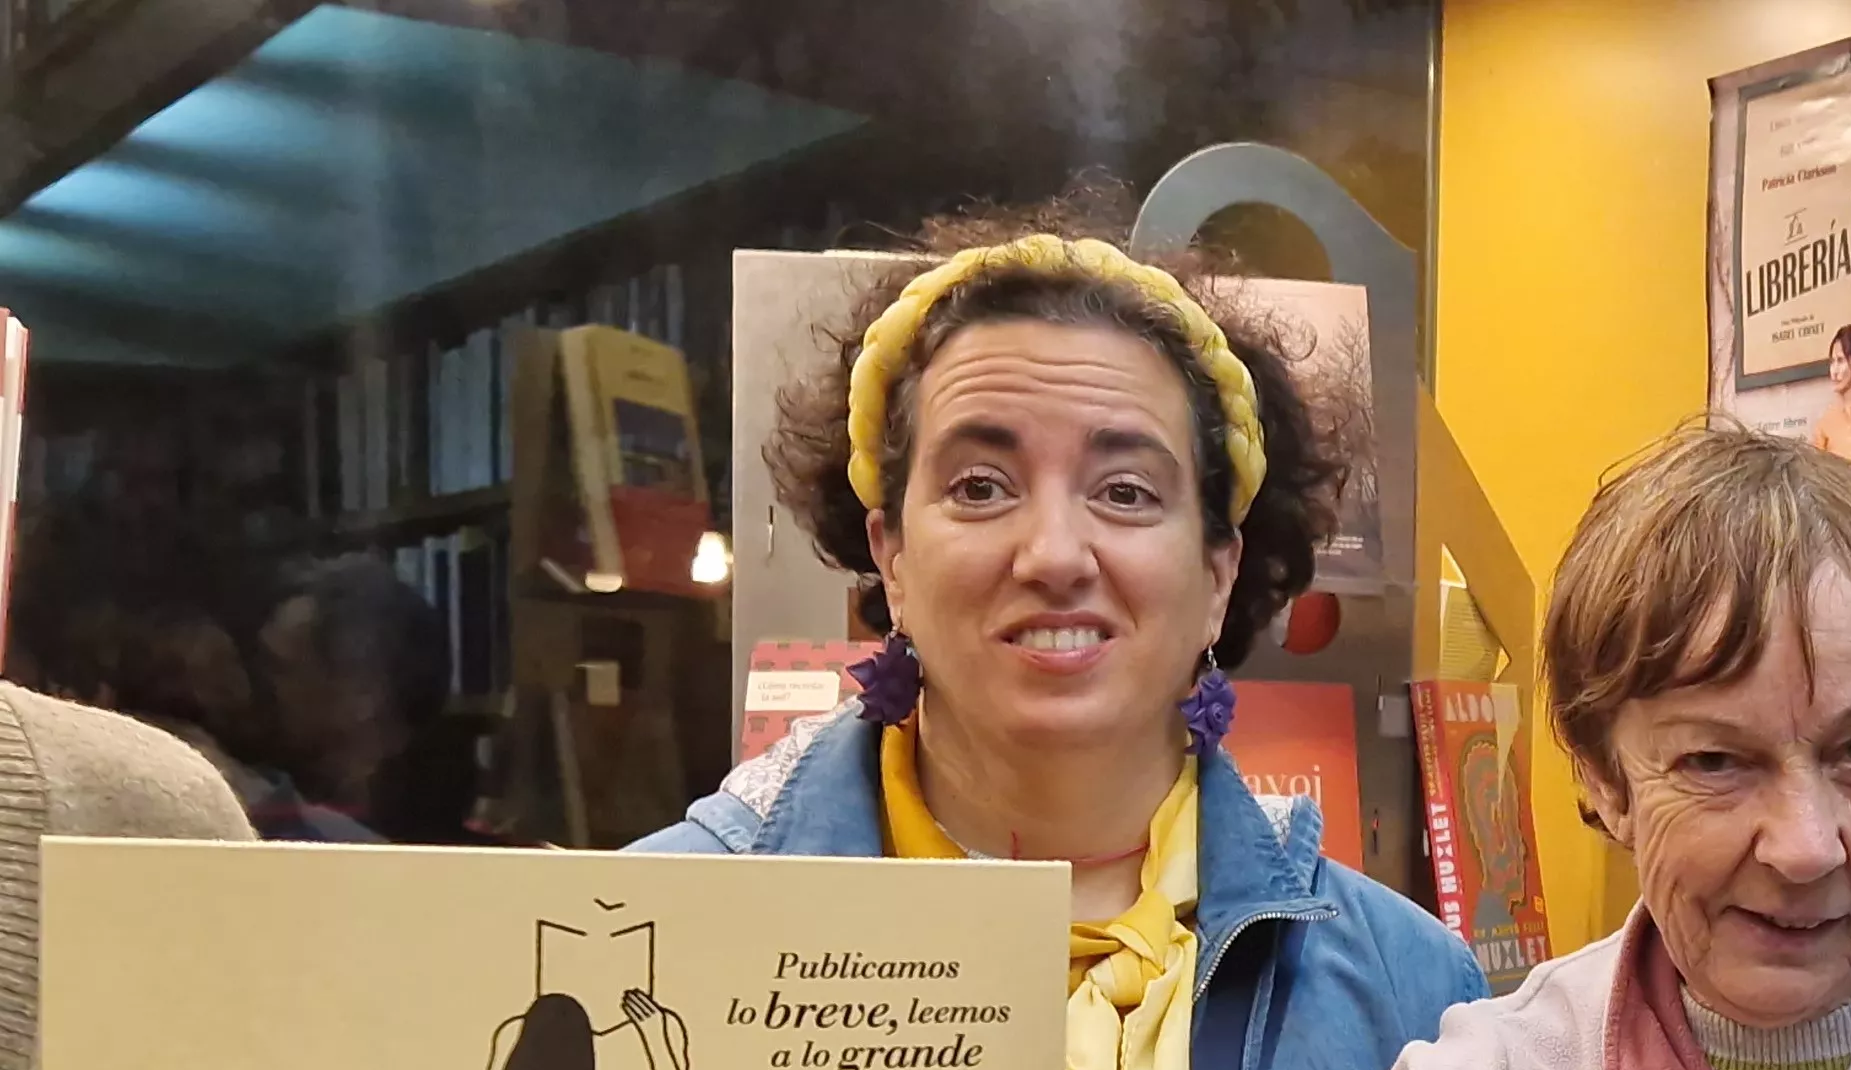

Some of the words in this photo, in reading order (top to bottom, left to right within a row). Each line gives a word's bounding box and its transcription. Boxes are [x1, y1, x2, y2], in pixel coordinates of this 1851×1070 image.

[1746, 218, 1851, 318] LIBRERÍA
[1243, 764, 1322, 806] avoj
[773, 951, 960, 980] Publicamos
[1475, 935, 1547, 973] HUXLEY
[726, 997, 758, 1026] lo
[764, 990, 900, 1036] breve,
[906, 997, 1012, 1025] leemos
[770, 1049, 791, 1068] a
[801, 1040, 831, 1068] lo
